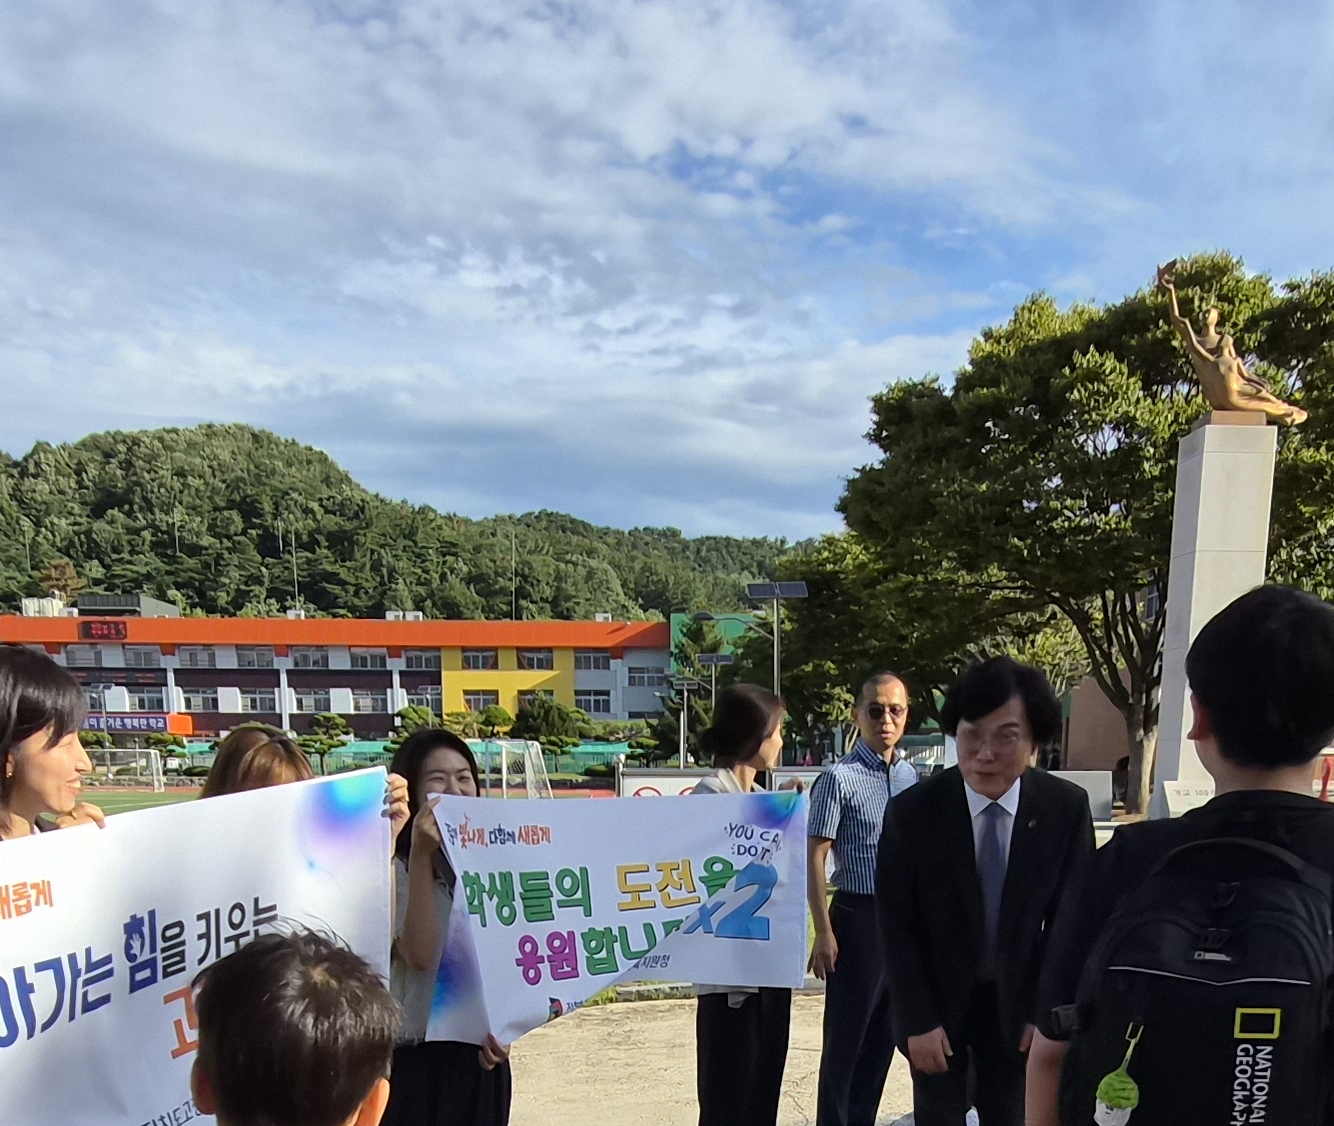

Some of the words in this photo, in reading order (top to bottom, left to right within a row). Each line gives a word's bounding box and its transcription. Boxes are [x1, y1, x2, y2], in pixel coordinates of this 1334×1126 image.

[517, 825, 551, 845] 새롭게
[729, 822, 754, 840] YOU
[462, 866, 592, 927] 학생들의
[616, 855, 740, 913] 도전을
[123, 908, 187, 995] 힘을
[195, 896, 279, 966] 키우는
